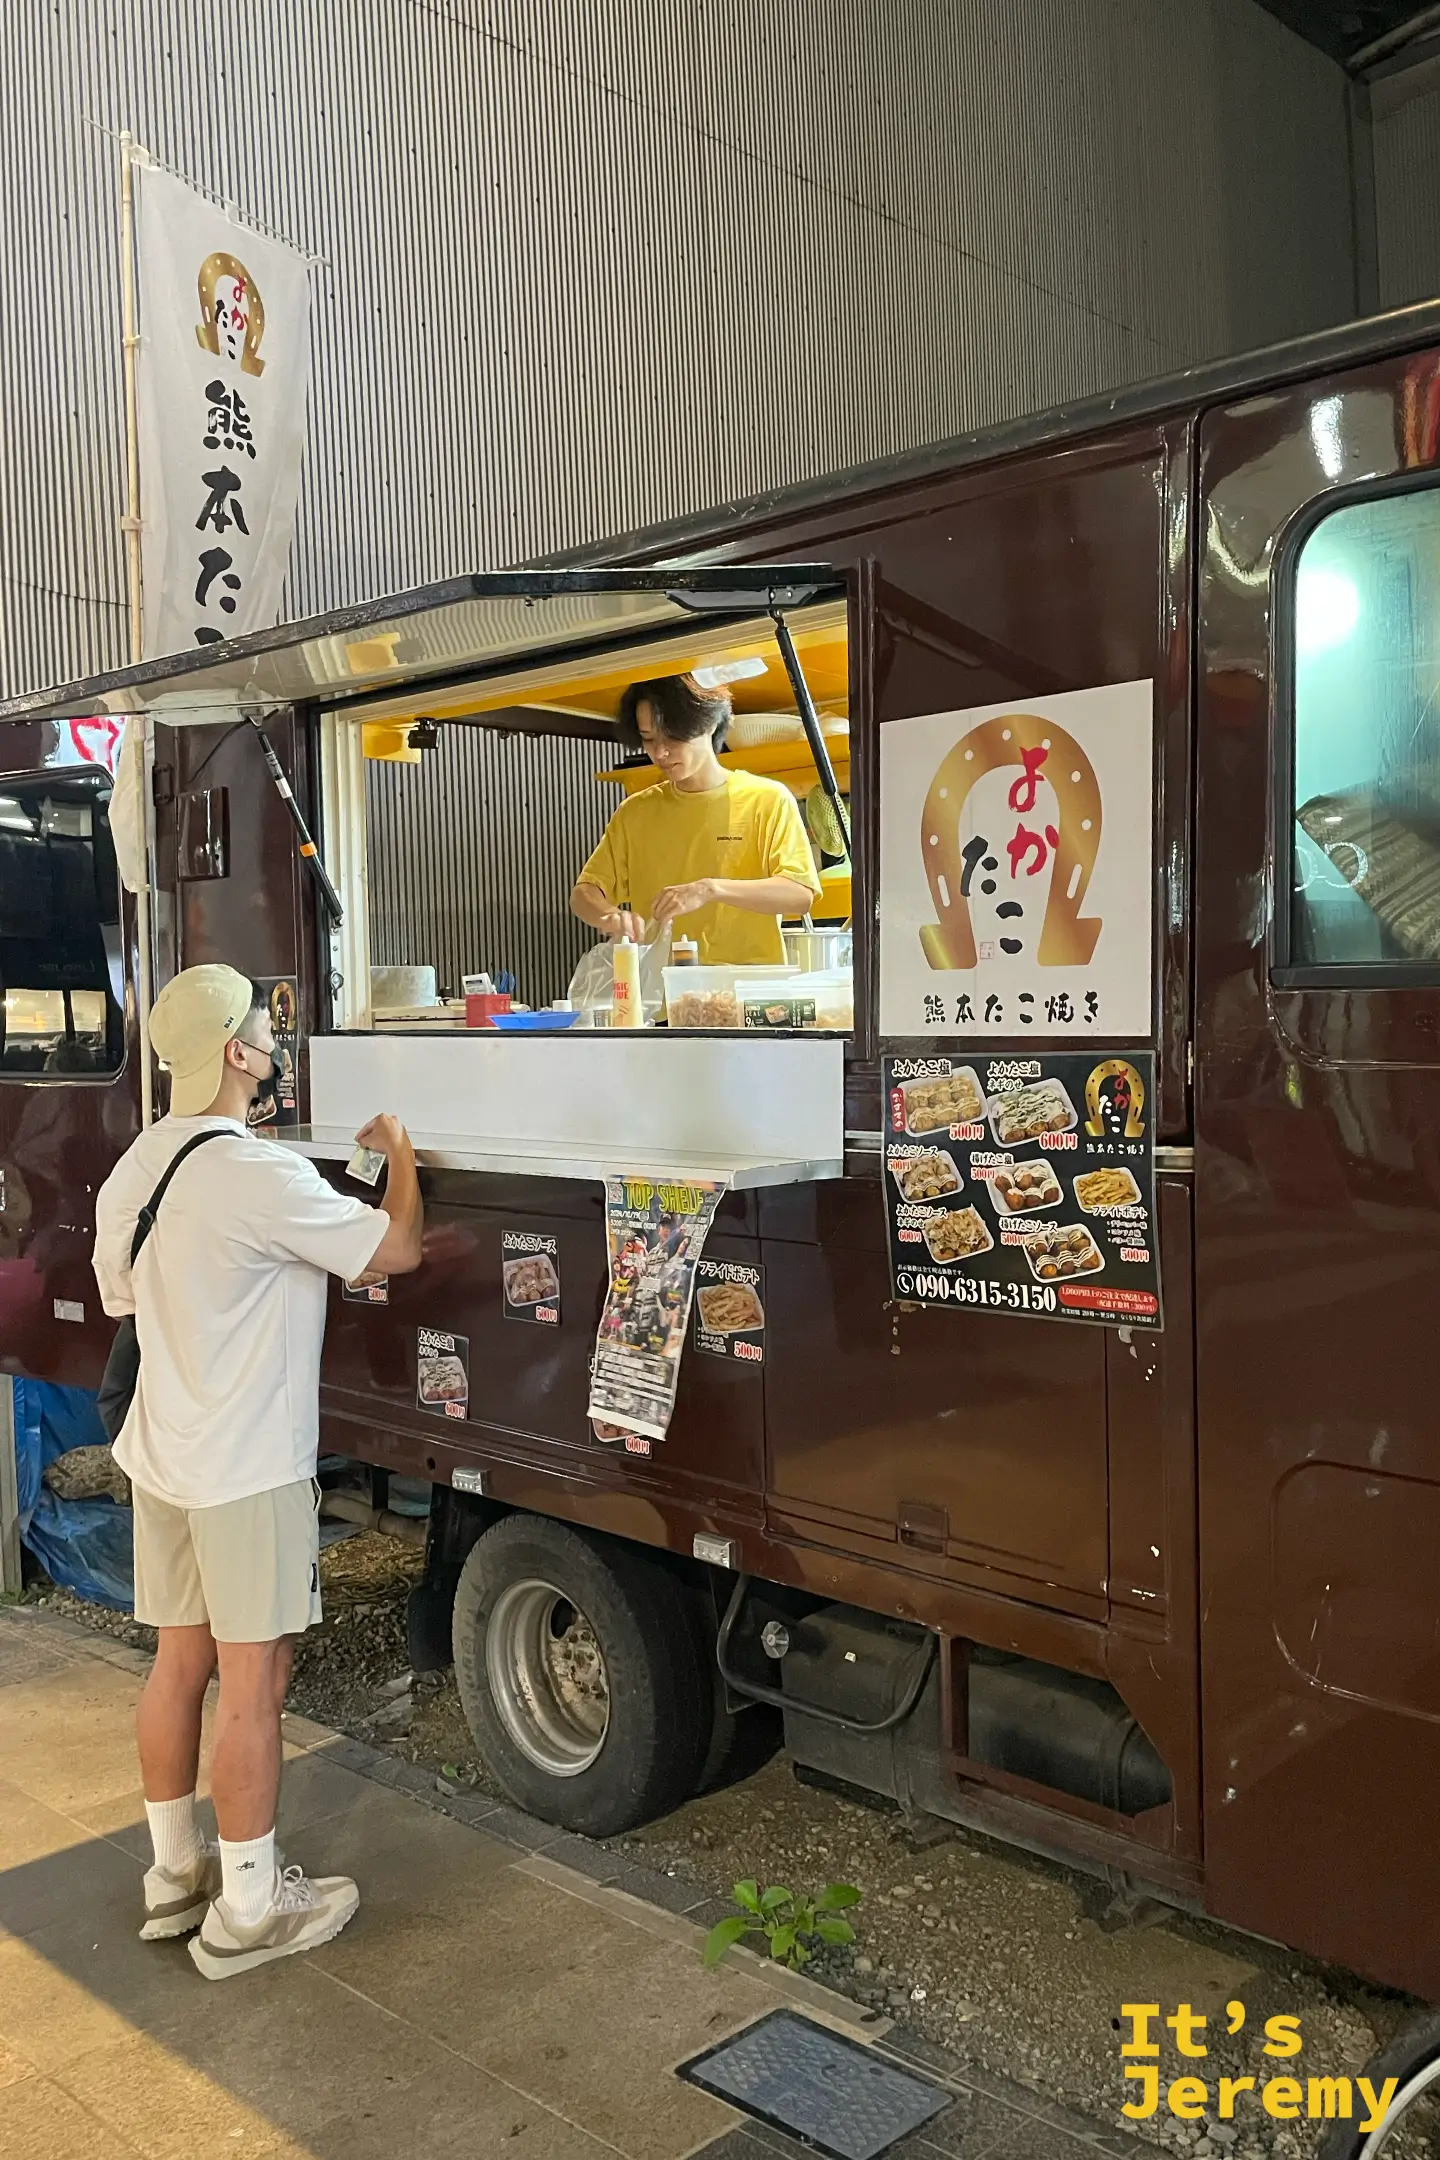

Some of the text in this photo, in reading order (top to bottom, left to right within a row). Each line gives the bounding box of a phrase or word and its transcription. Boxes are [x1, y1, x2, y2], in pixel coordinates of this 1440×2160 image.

[1007, 746, 1060, 879] よか
[960, 835, 1024, 954] たこ
[923, 990, 1099, 1025] 熊本たこ焼き
[891, 1058, 952, 1078] よかたこ塩
[987, 1060, 1041, 1078] よかたこ塩
[987, 1078, 1024, 1091] ネギのせ
[1113, 1068, 1132, 1110] よか
[1098, 1094, 1120, 1133] たこ
[949, 1122, 985, 1141] 500円
[1039, 1131, 1079, 1150] 600円
[887, 1144, 939, 1158] よかたこソース
[970, 1151, 1014, 1167] 揚げたこ塩
[887, 1158, 912, 1172] 500円
[970, 1166, 996, 1180] 500円
[622, 1182, 654, 1211] TOP
[657, 1184, 704, 1216] SHELF
[896, 1203, 949, 1219] よかたこソース
[999, 1217, 1058, 1233] 揚げたこソース
[503, 1233, 557, 1254] よかたこソース
[898, 1229, 923, 1242] 600円
[1000, 1232, 1027, 1246] 500円
[1120, 1247, 1150, 1262] 500円
[698, 1260, 760, 1286] フライドポテト
[915, 1273, 1057, 1311] 090-6315-3150
[535, 1306, 558, 1322] 500円
[418, 1330, 456, 1352] よかたこ塩
[734, 1340, 763, 1361] 500円
[444, 1401, 466, 1419] 600円
[625, 1436, 651, 1454] 600円
